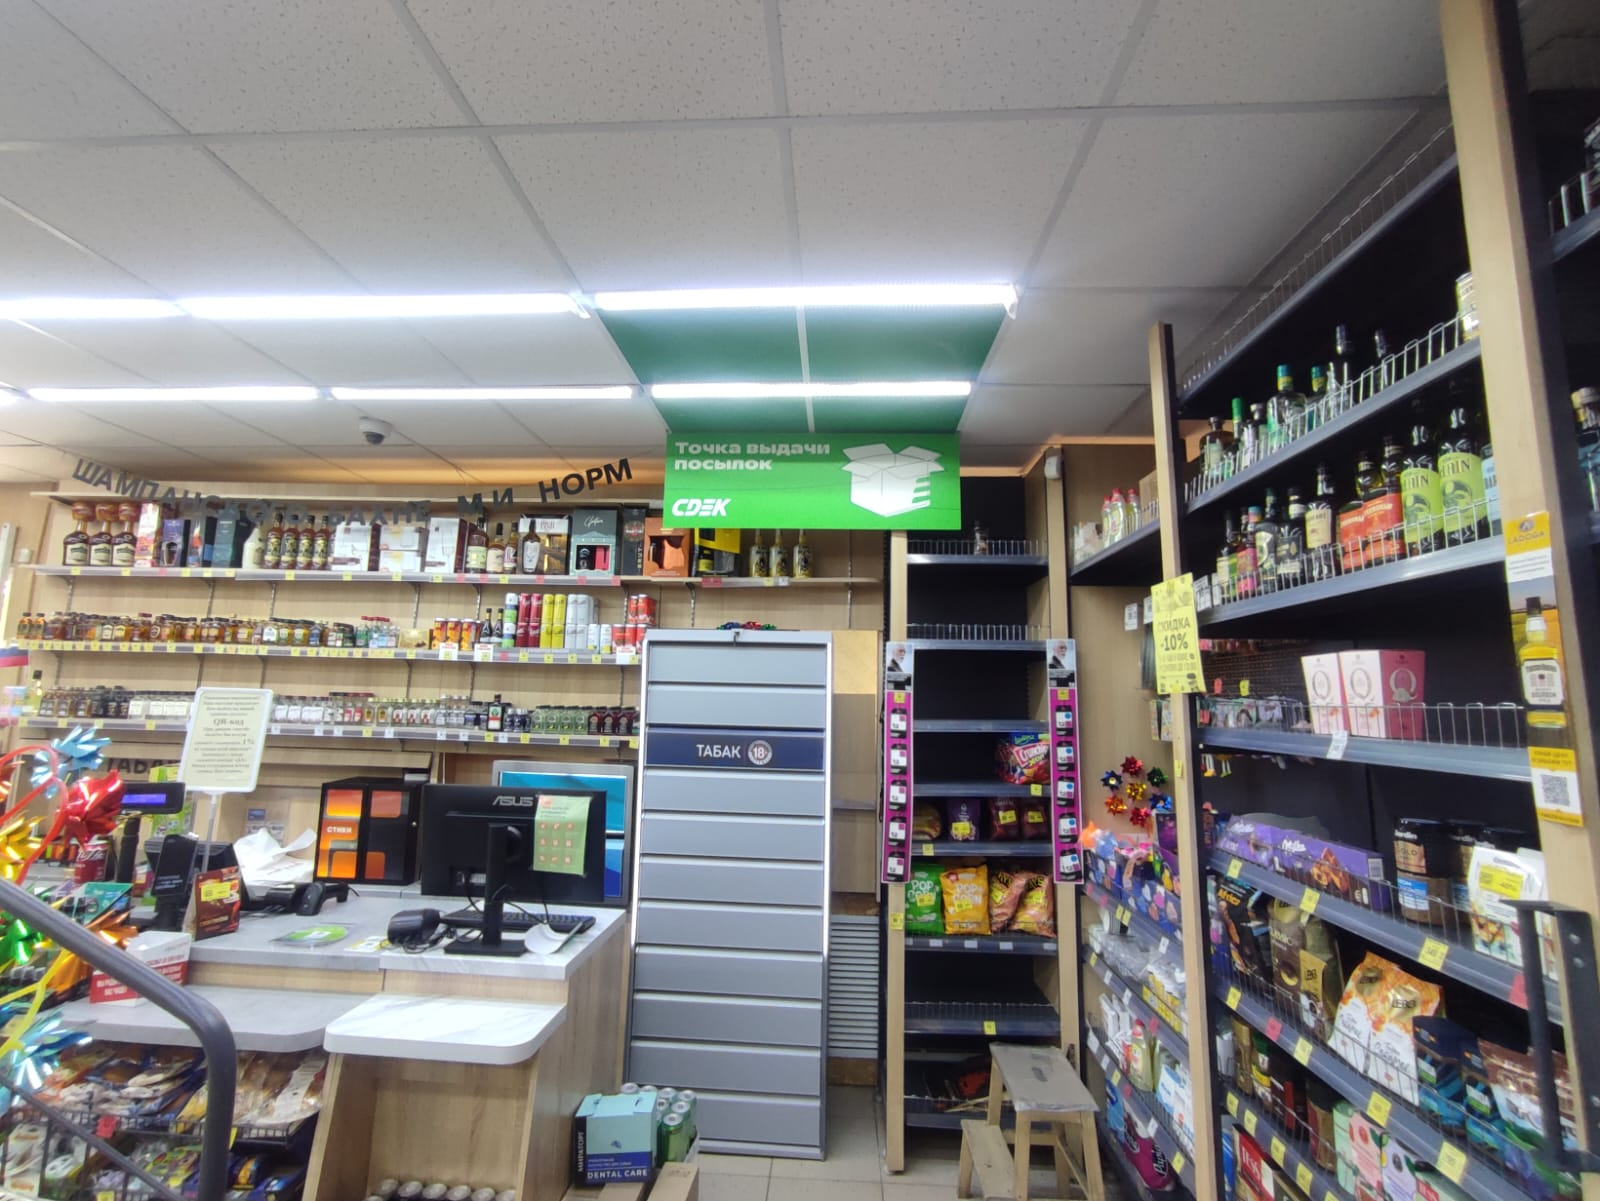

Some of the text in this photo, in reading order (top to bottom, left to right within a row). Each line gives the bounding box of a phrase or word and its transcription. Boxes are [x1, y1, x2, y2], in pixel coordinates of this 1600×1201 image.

[675, 442, 831, 456] Точка выдачи
[674, 458, 772, 471] посылок
[492, 487, 514, 508] И
[538, 458, 632, 503] НОРМ
[671, 498, 732, 517] CDEK
[1161, 632, 1188, 652] -10%
[696, 744, 741, 759] ТАБАК
[492, 795, 534, 807] ASUS
[911, 880, 935, 892] POP
[587, 1168, 648, 1179] DENTAL CARE
